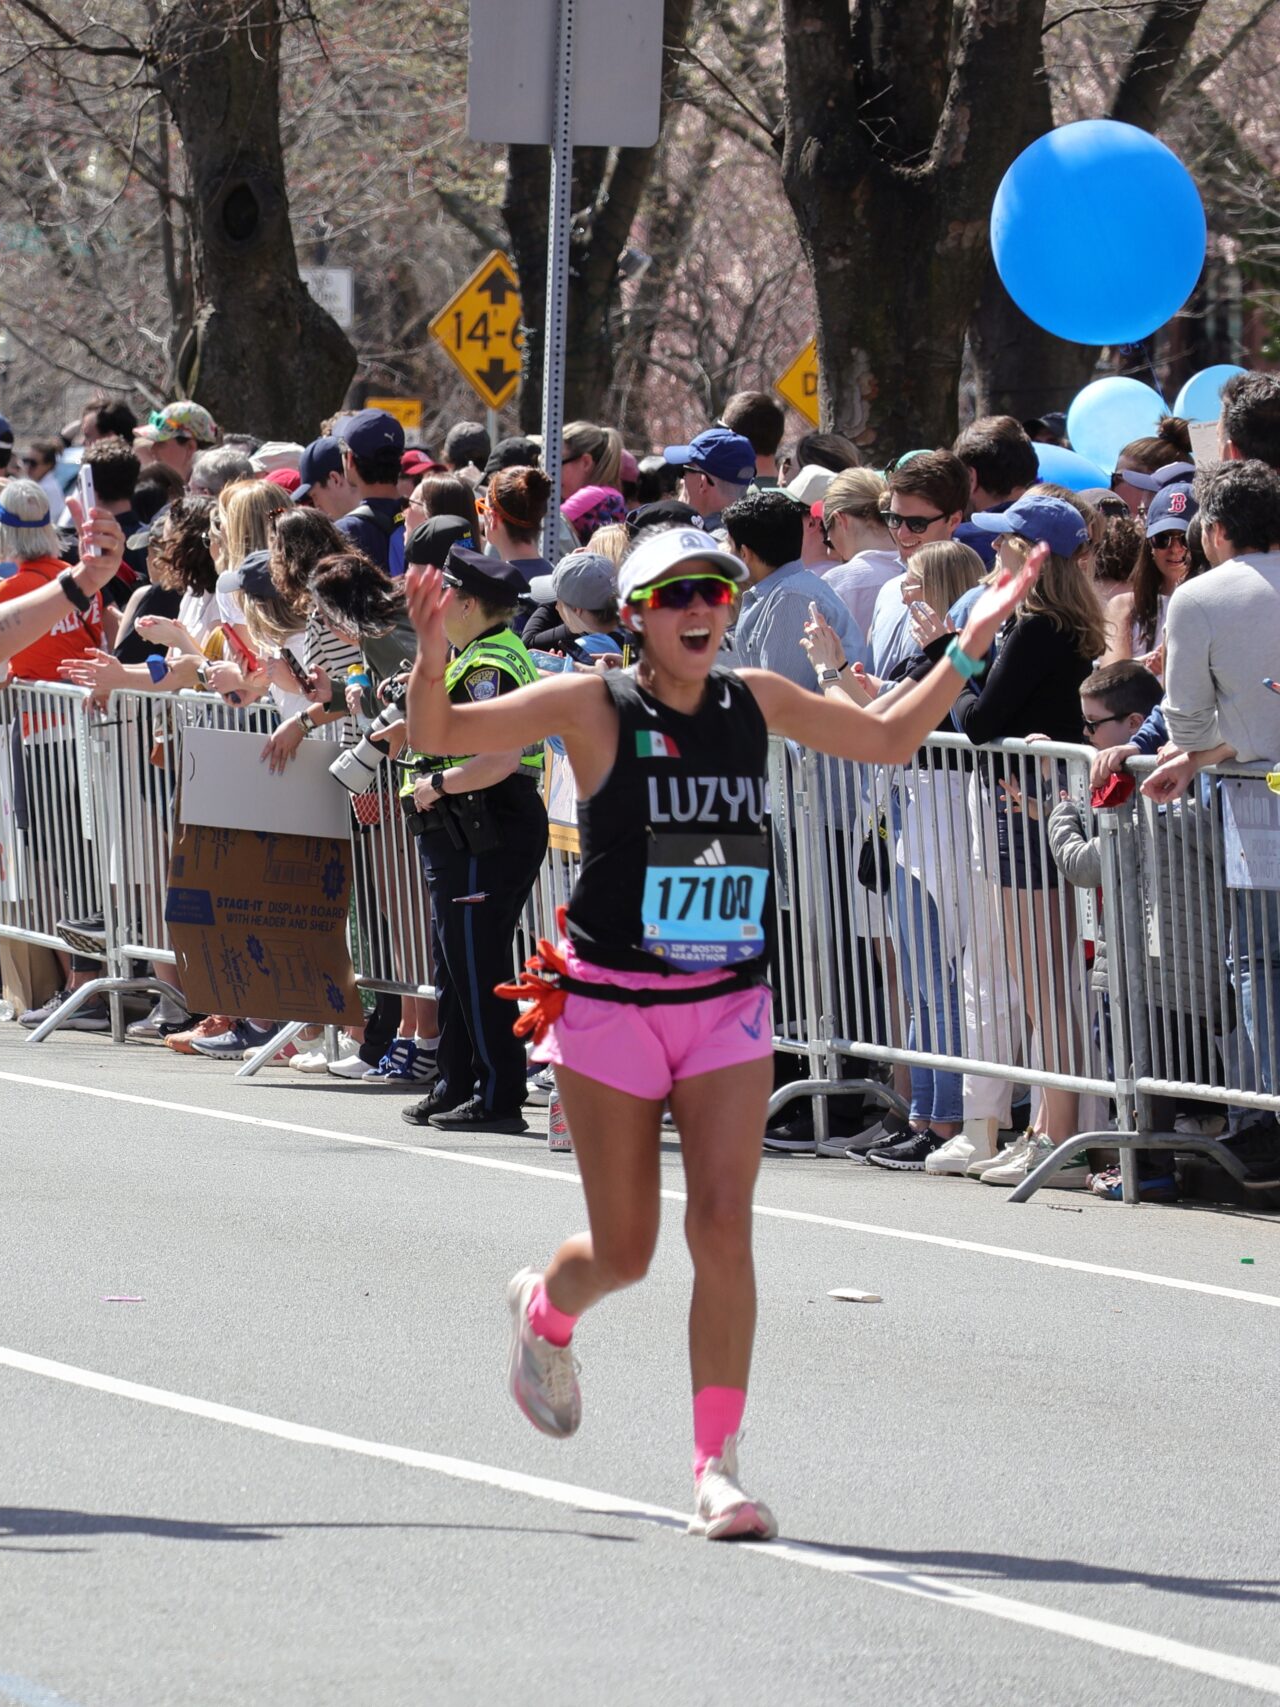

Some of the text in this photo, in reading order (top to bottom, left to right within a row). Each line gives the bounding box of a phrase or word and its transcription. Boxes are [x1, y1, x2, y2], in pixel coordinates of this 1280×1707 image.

[1168, 492, 1187, 513] B
[216, 897, 263, 912] STAGE-IT
[268, 902, 308, 917] DISPLAY
[311, 904, 345, 919] BOARD
[227, 912, 337, 932] WITH HEADER AND SHELF
[649, 926, 658, 936] 2
[691, 944, 727, 954] BOSTON
[670, 952, 727, 962] MARATHON
